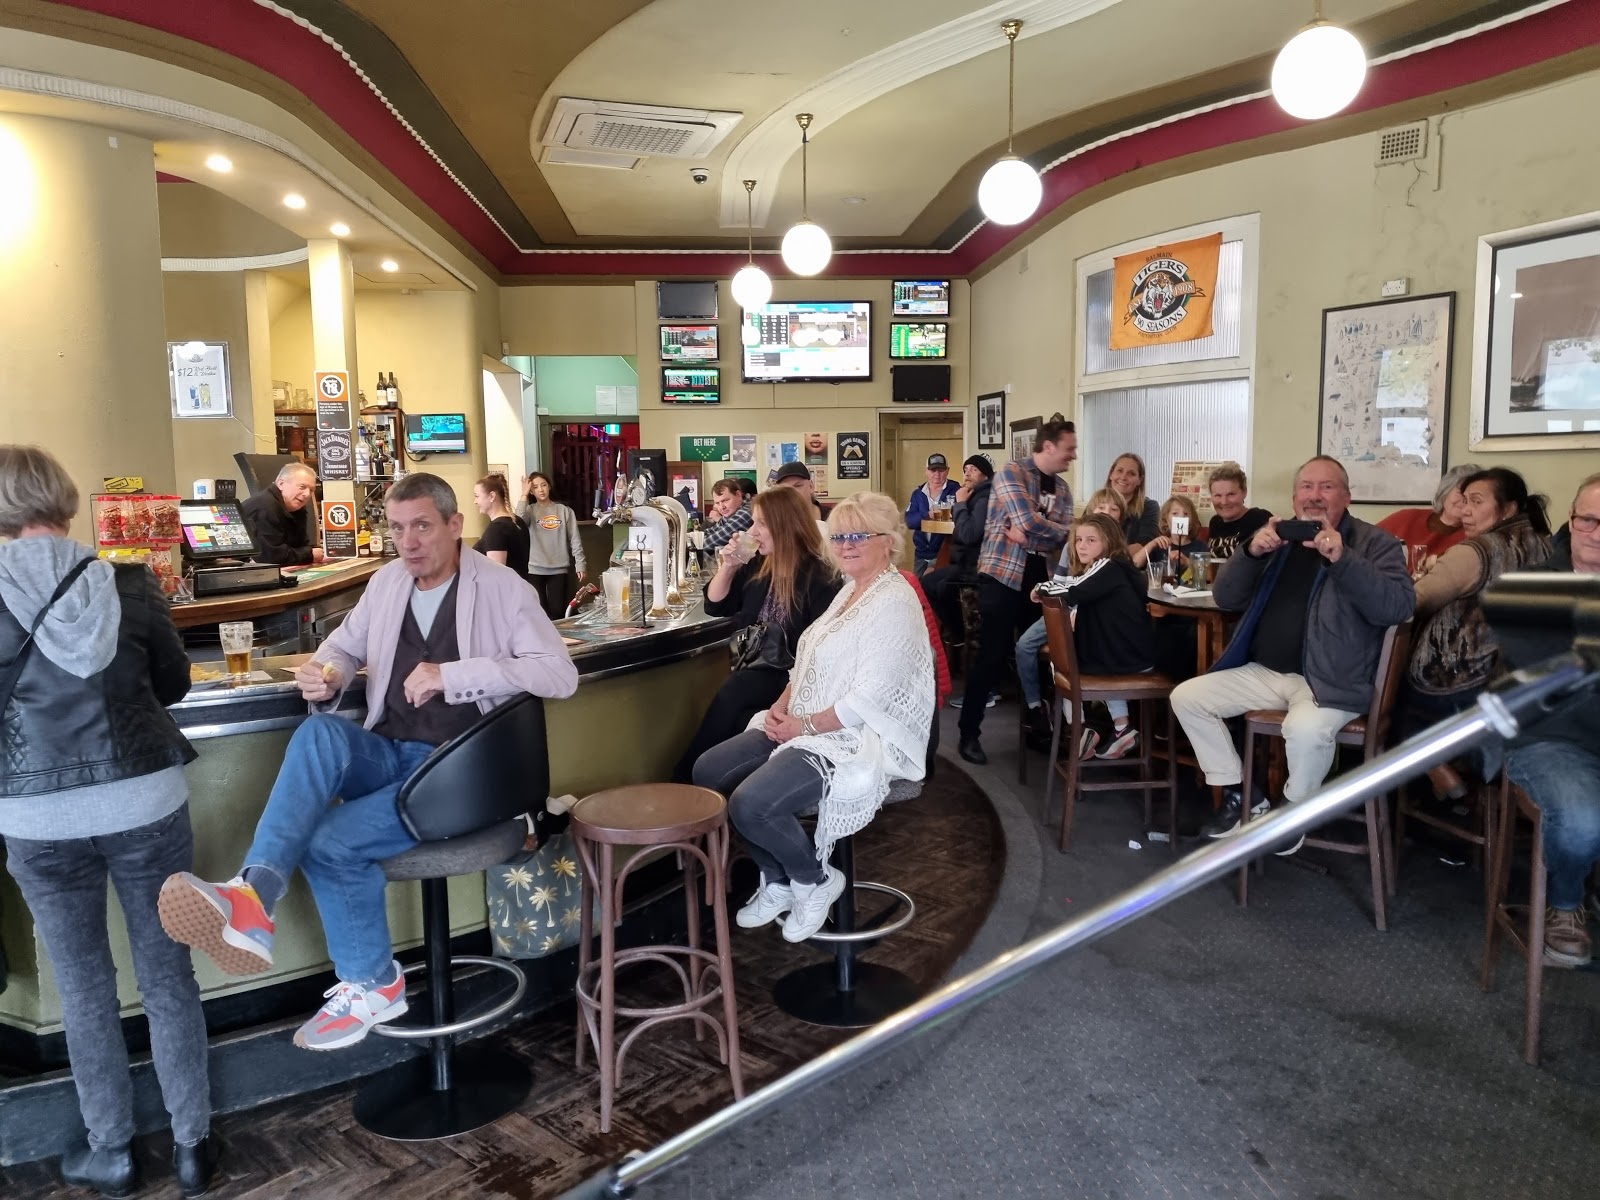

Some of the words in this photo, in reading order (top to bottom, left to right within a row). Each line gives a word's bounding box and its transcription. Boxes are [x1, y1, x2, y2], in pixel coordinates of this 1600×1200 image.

[1146, 252, 1172, 261] BALMAIN
[1136, 260, 1183, 280] TIGERS
[1174, 282, 1194, 295] 1908
[1137, 318, 1144, 328] 90
[1146, 310, 1183, 331] SEASONS
[177, 367, 193, 377] $12
[320, 436, 332, 447] JACK
[693, 438, 703, 447] BET
[703, 438, 717, 446] HERE
